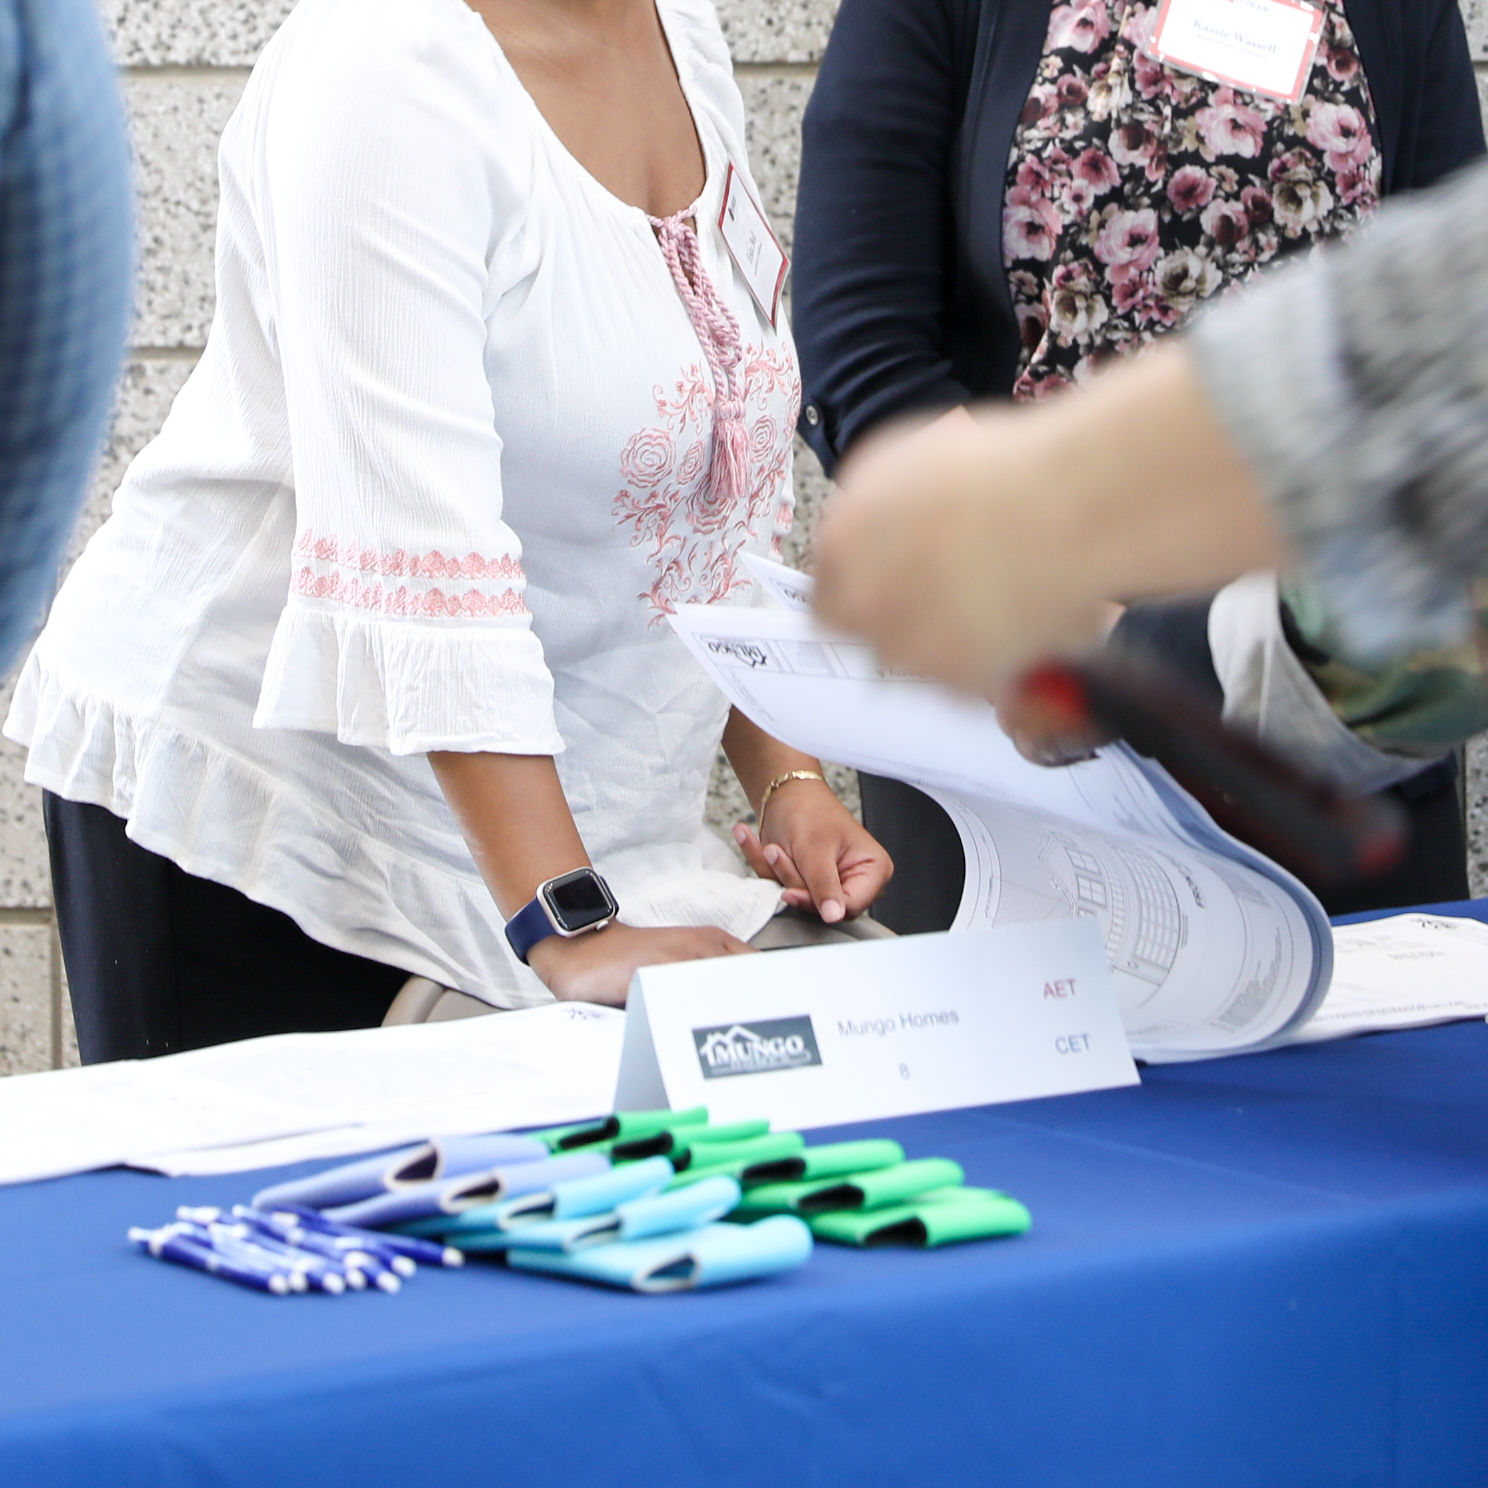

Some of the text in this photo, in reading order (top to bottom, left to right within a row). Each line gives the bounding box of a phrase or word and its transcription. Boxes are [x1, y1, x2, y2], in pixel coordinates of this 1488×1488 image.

[1043, 978, 1077, 999] AET
[837, 1010, 959, 1037] Mungo Homes
[711, 1034, 805, 1067] MUNGO
[1054, 1033, 1090, 1054] CET
